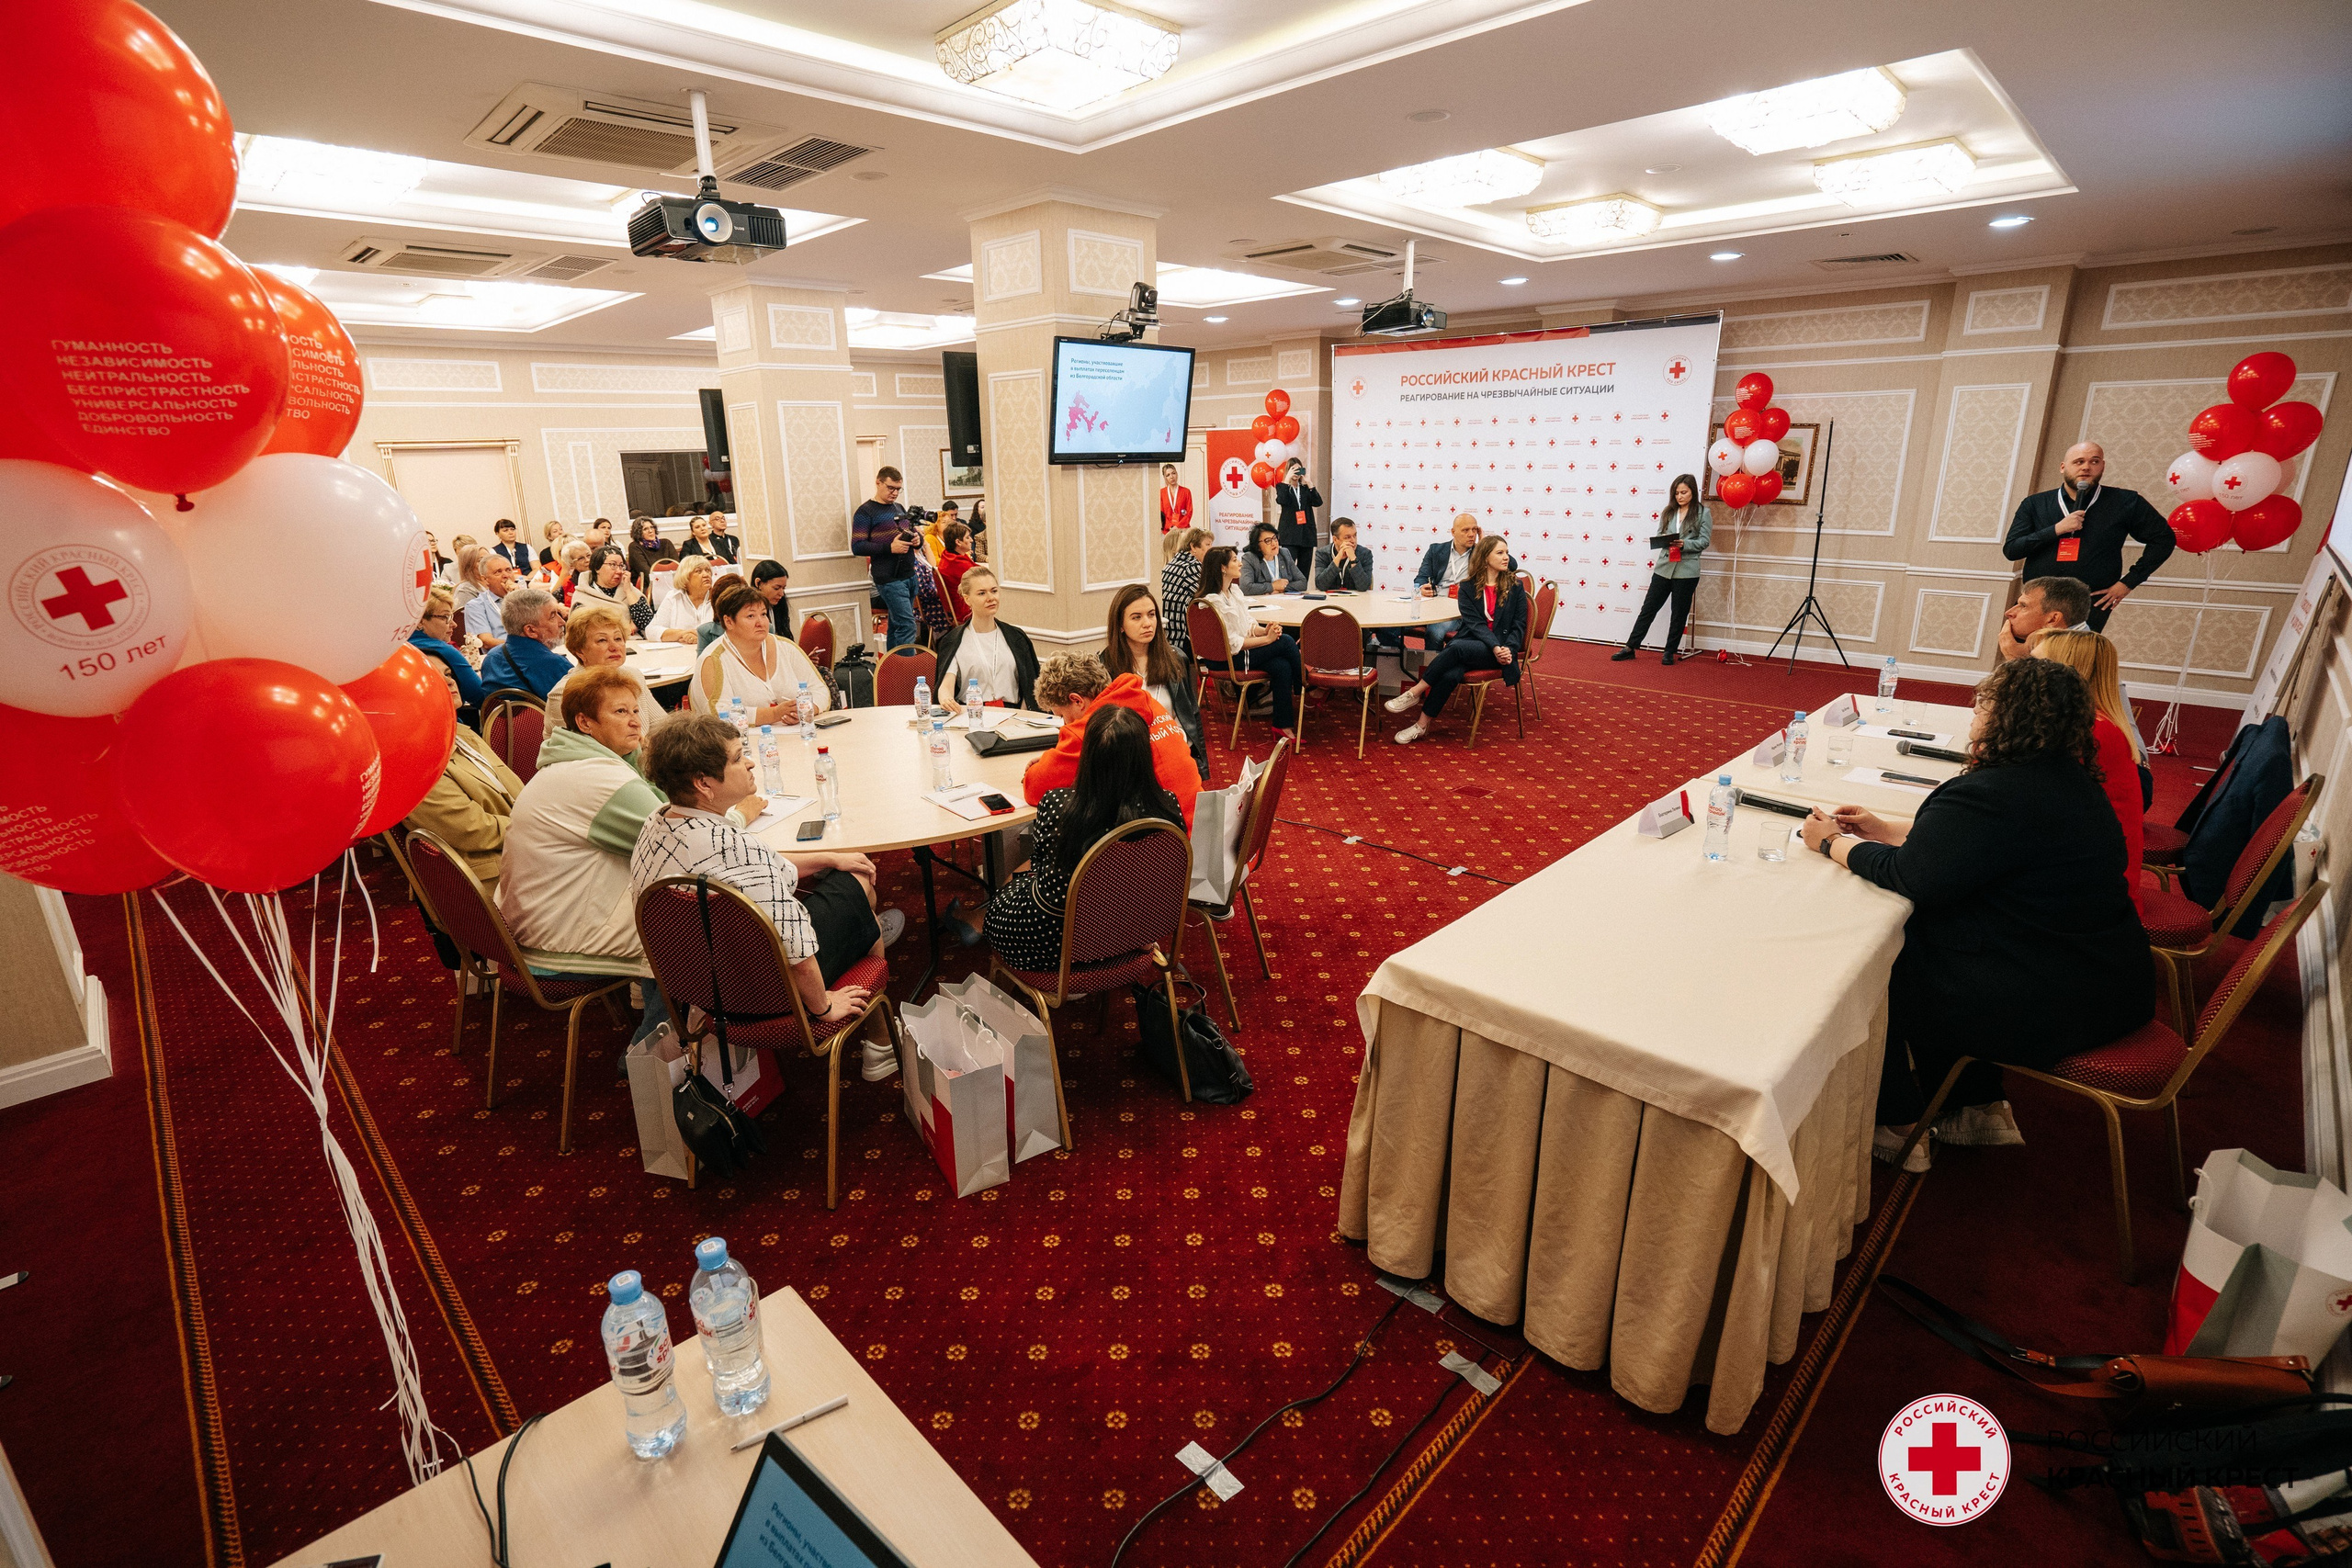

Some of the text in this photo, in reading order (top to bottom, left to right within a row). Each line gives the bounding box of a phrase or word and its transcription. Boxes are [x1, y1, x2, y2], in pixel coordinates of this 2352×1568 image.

[51, 339, 173, 355] ГУМАННОСТЬ
[56, 355, 213, 369] НЕЗАВИСИМОСТЬ
[62, 368, 212, 383] НЕЙТРАЛЬНОСТЬ
[1400, 362, 1617, 387] РОССИЙСКИЙ КРАСНЫЙ КРЕСТ
[66, 384, 251, 397] БЕСПРИСТРАСТНОСТЬ
[291, 384, 355, 404] САЛЬНОСТЬ
[1400, 384, 1615, 402] РЕАГИРОВАНИЕ НА ЧРЕЗВЫЧАЙНЫЕ СИТУАЦИИ
[71, 398, 238, 411] УНИВЕРСАЛЬНОСТЬ
[78, 411, 234, 423] ДОБРОВОЛЬНОСТЬ
[82, 423, 171, 436] ЕДИНСТВО
[60, 635, 166, 681] 150 лет
